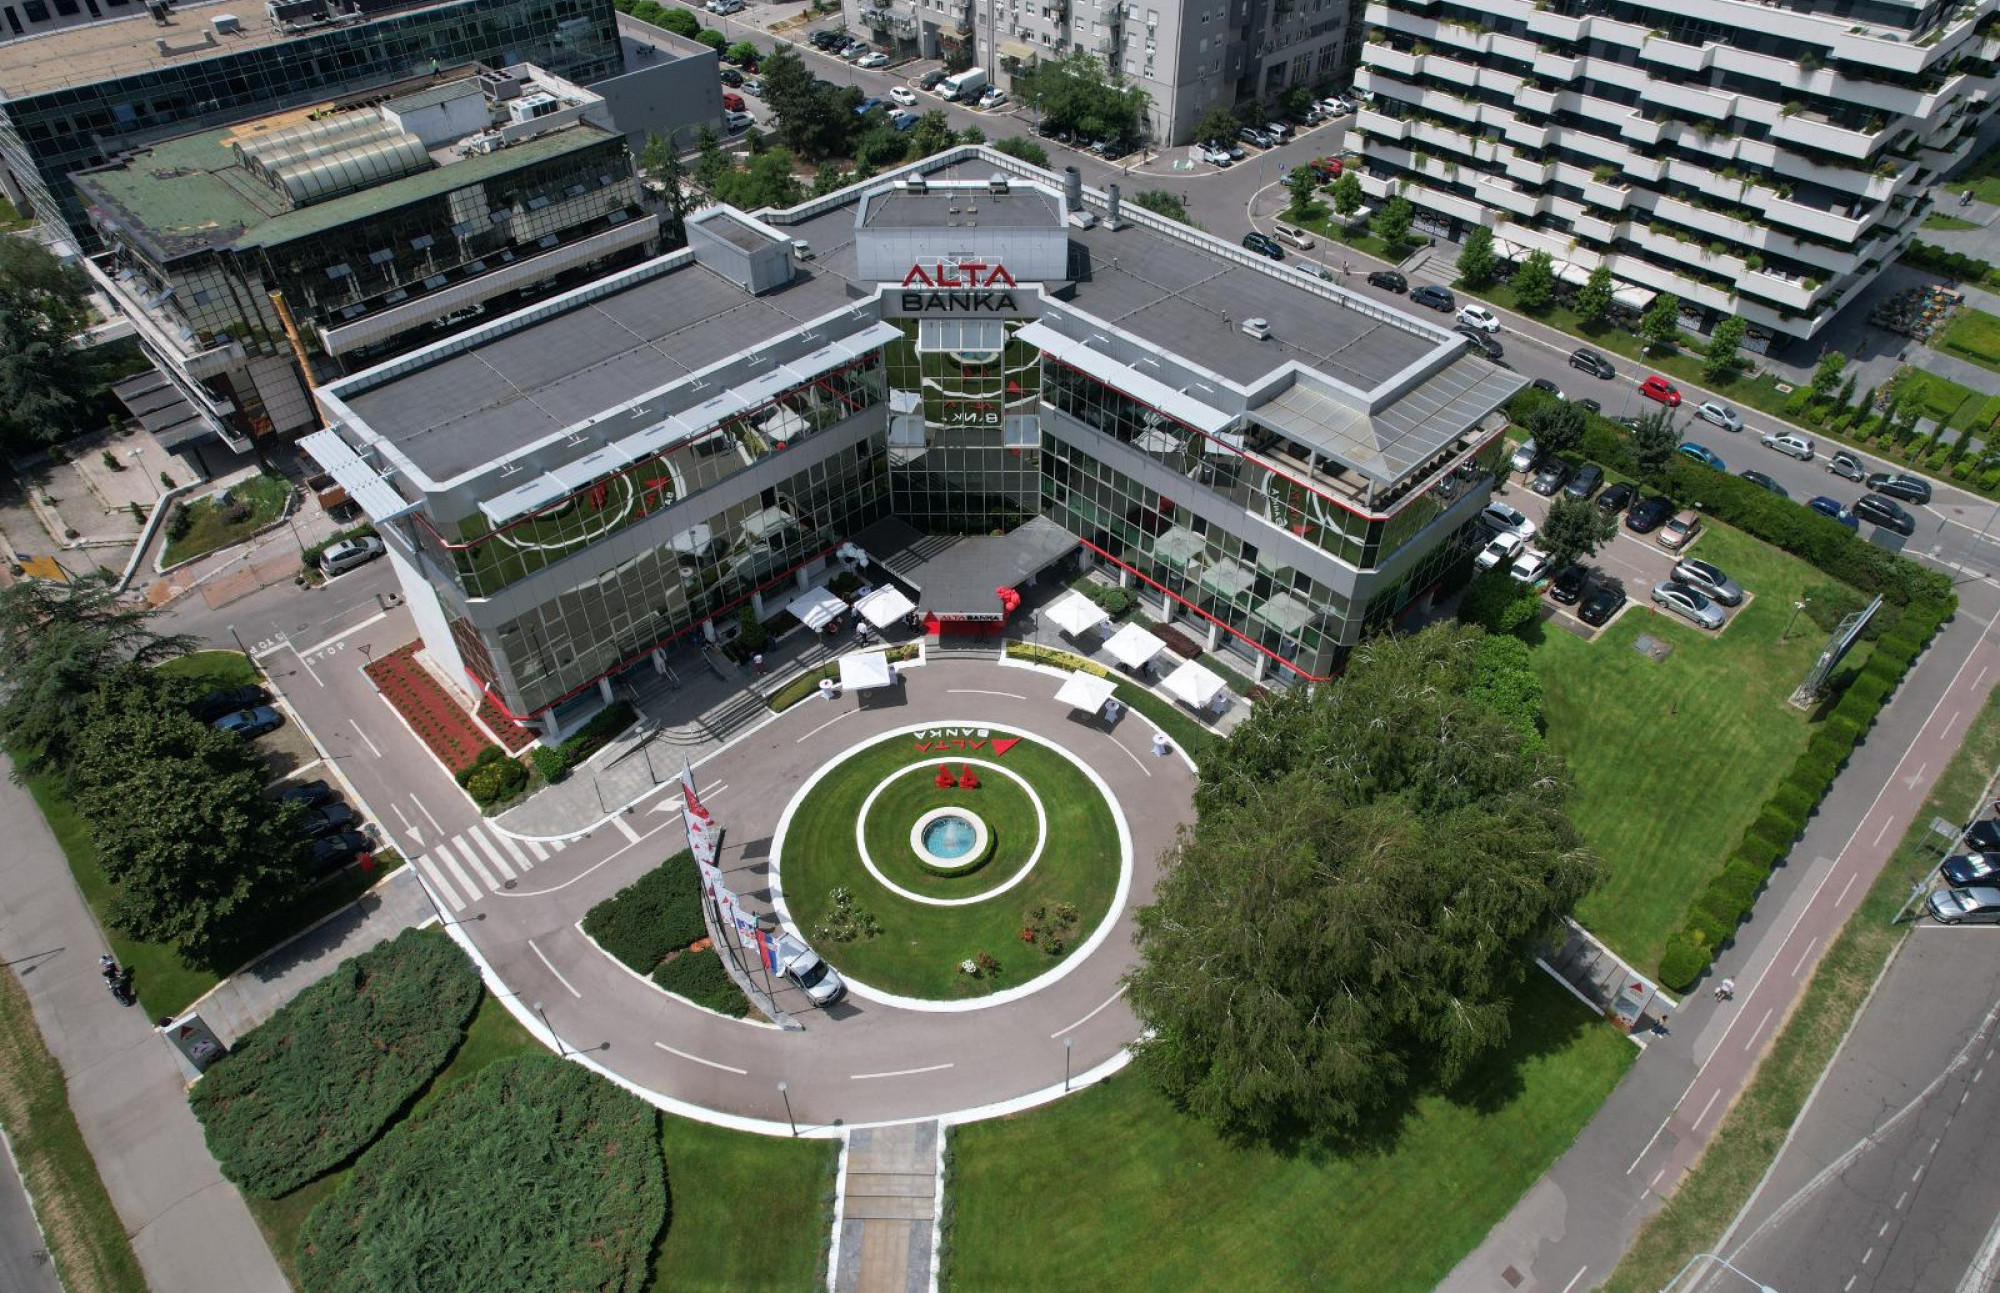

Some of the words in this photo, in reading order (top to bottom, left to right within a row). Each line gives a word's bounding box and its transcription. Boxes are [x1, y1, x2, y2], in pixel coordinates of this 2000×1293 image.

[902, 263, 1017, 287] ALTA
[902, 293, 1018, 311] BANKA
[306, 641, 346, 666] STOP
[914, 728, 990, 740] BANKA
[914, 739, 987, 753] ALTA
